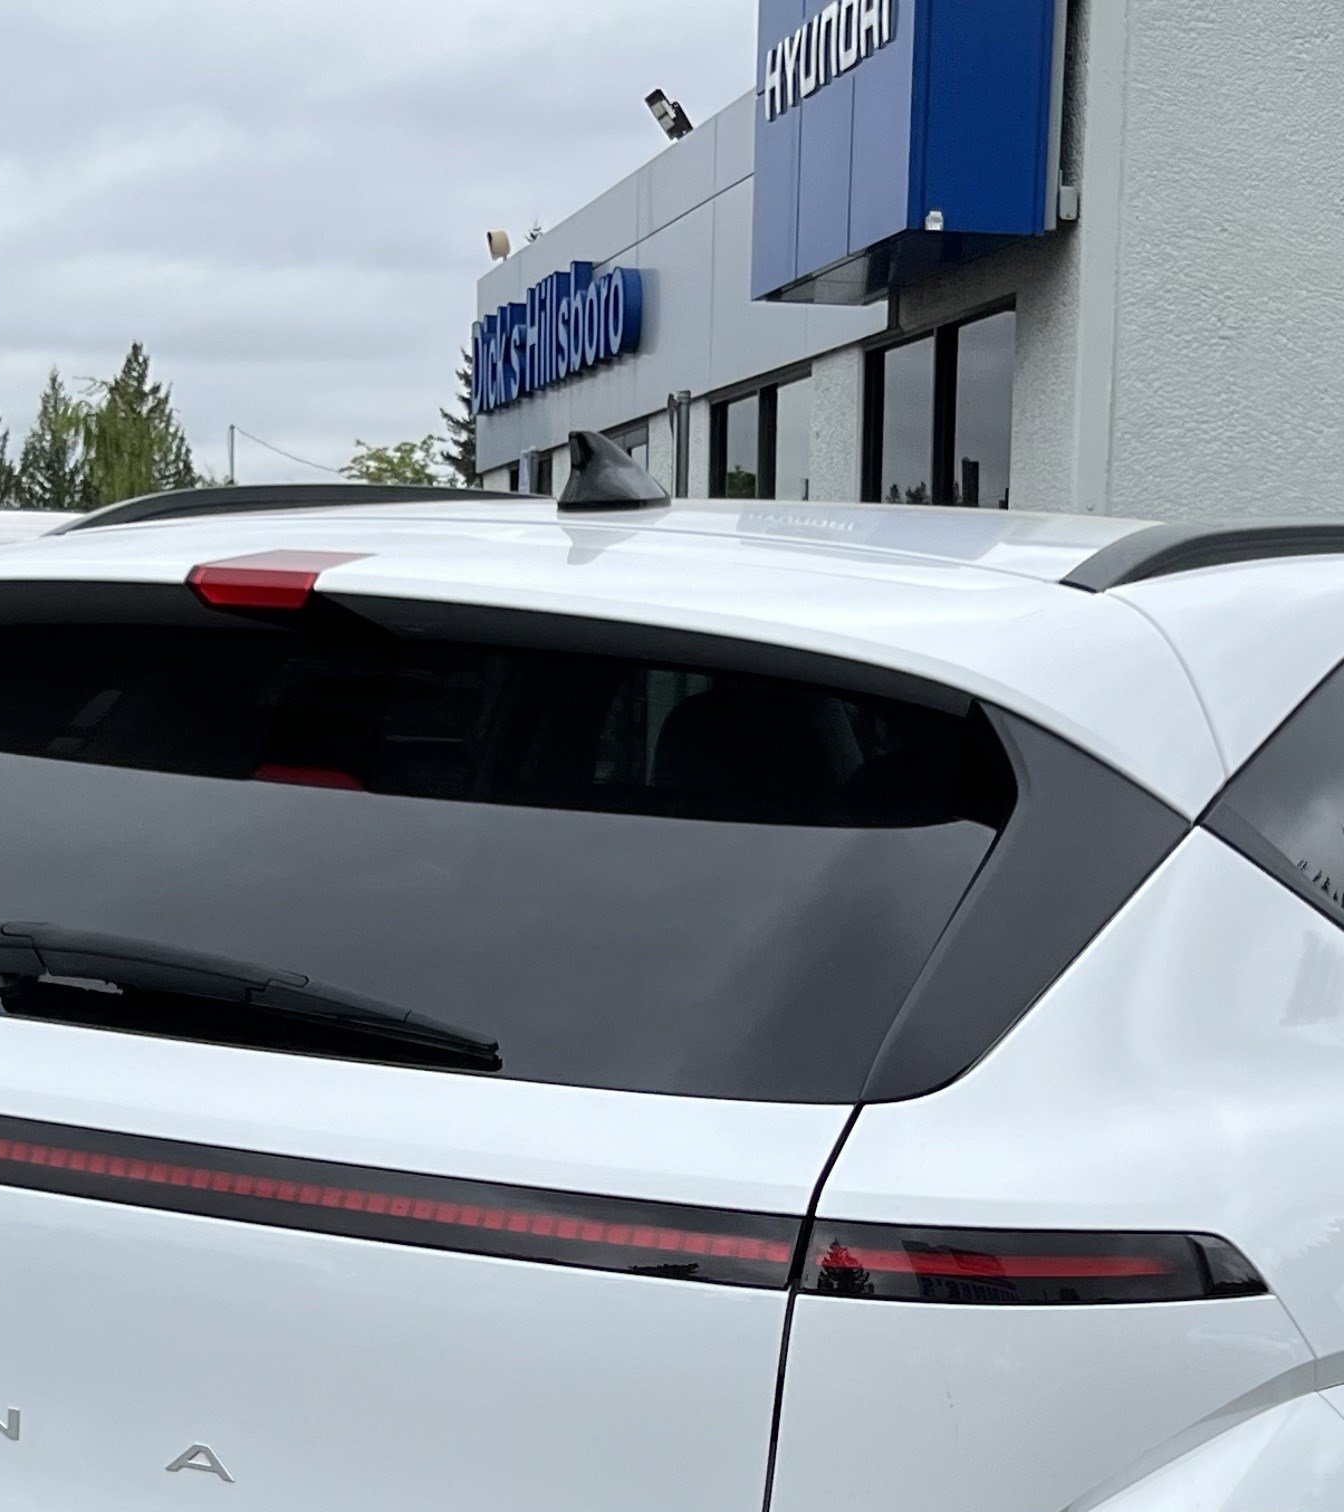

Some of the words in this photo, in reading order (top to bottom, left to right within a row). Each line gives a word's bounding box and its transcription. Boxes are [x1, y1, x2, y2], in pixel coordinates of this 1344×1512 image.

[764, 0, 890, 122] HYUNDAI
[471, 303, 521, 415] Dick's
[524, 261, 625, 392] Hillsboro
